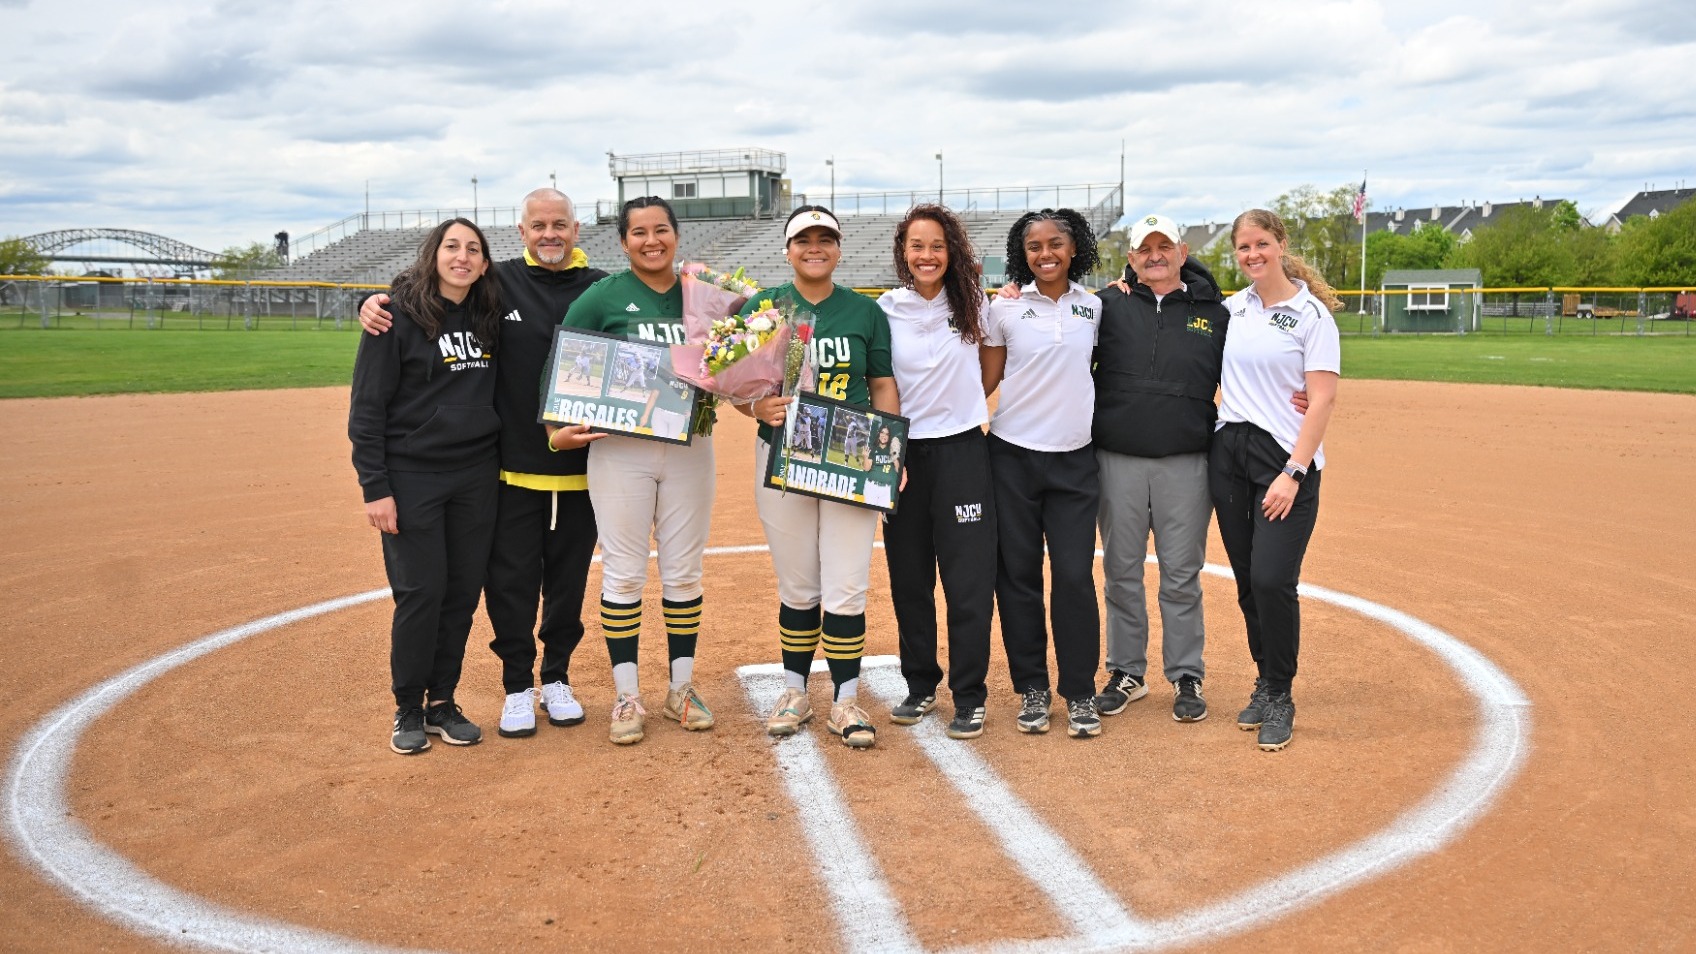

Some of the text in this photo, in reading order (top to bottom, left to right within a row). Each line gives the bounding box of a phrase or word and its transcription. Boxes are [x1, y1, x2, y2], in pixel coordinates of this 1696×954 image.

[638, 323, 687, 345] NJC
[1271, 312, 1299, 329] NJCU
[438, 331, 484, 360] NJC
[809, 336, 851, 368] JCU
[558, 398, 638, 433] ROSALES
[786, 462, 857, 501] ANDRADE
[955, 503, 982, 518] NJCU
